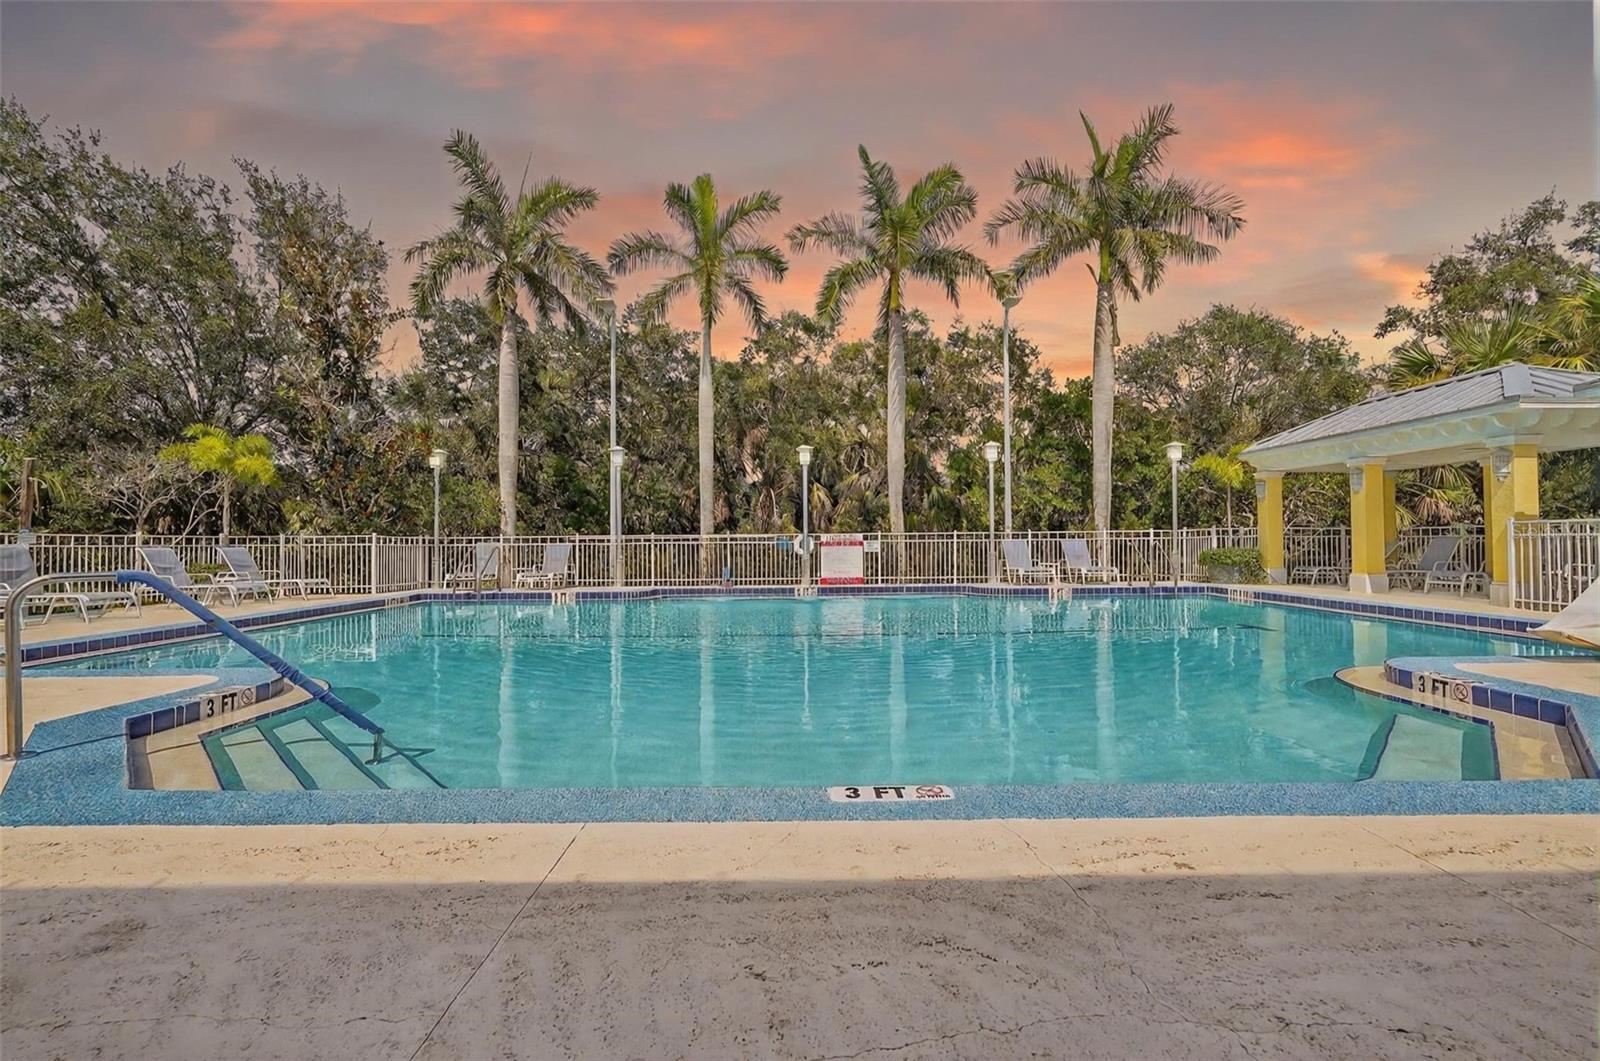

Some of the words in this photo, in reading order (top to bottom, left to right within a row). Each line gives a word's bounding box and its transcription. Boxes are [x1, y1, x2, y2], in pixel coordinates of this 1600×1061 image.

[1418, 675, 1426, 693] 3
[1431, 678, 1449, 698] FT
[207, 698, 215, 718] 3
[221, 692, 238, 713] FT
[844, 786, 861, 799] 3
[872, 786, 906, 799] FT
